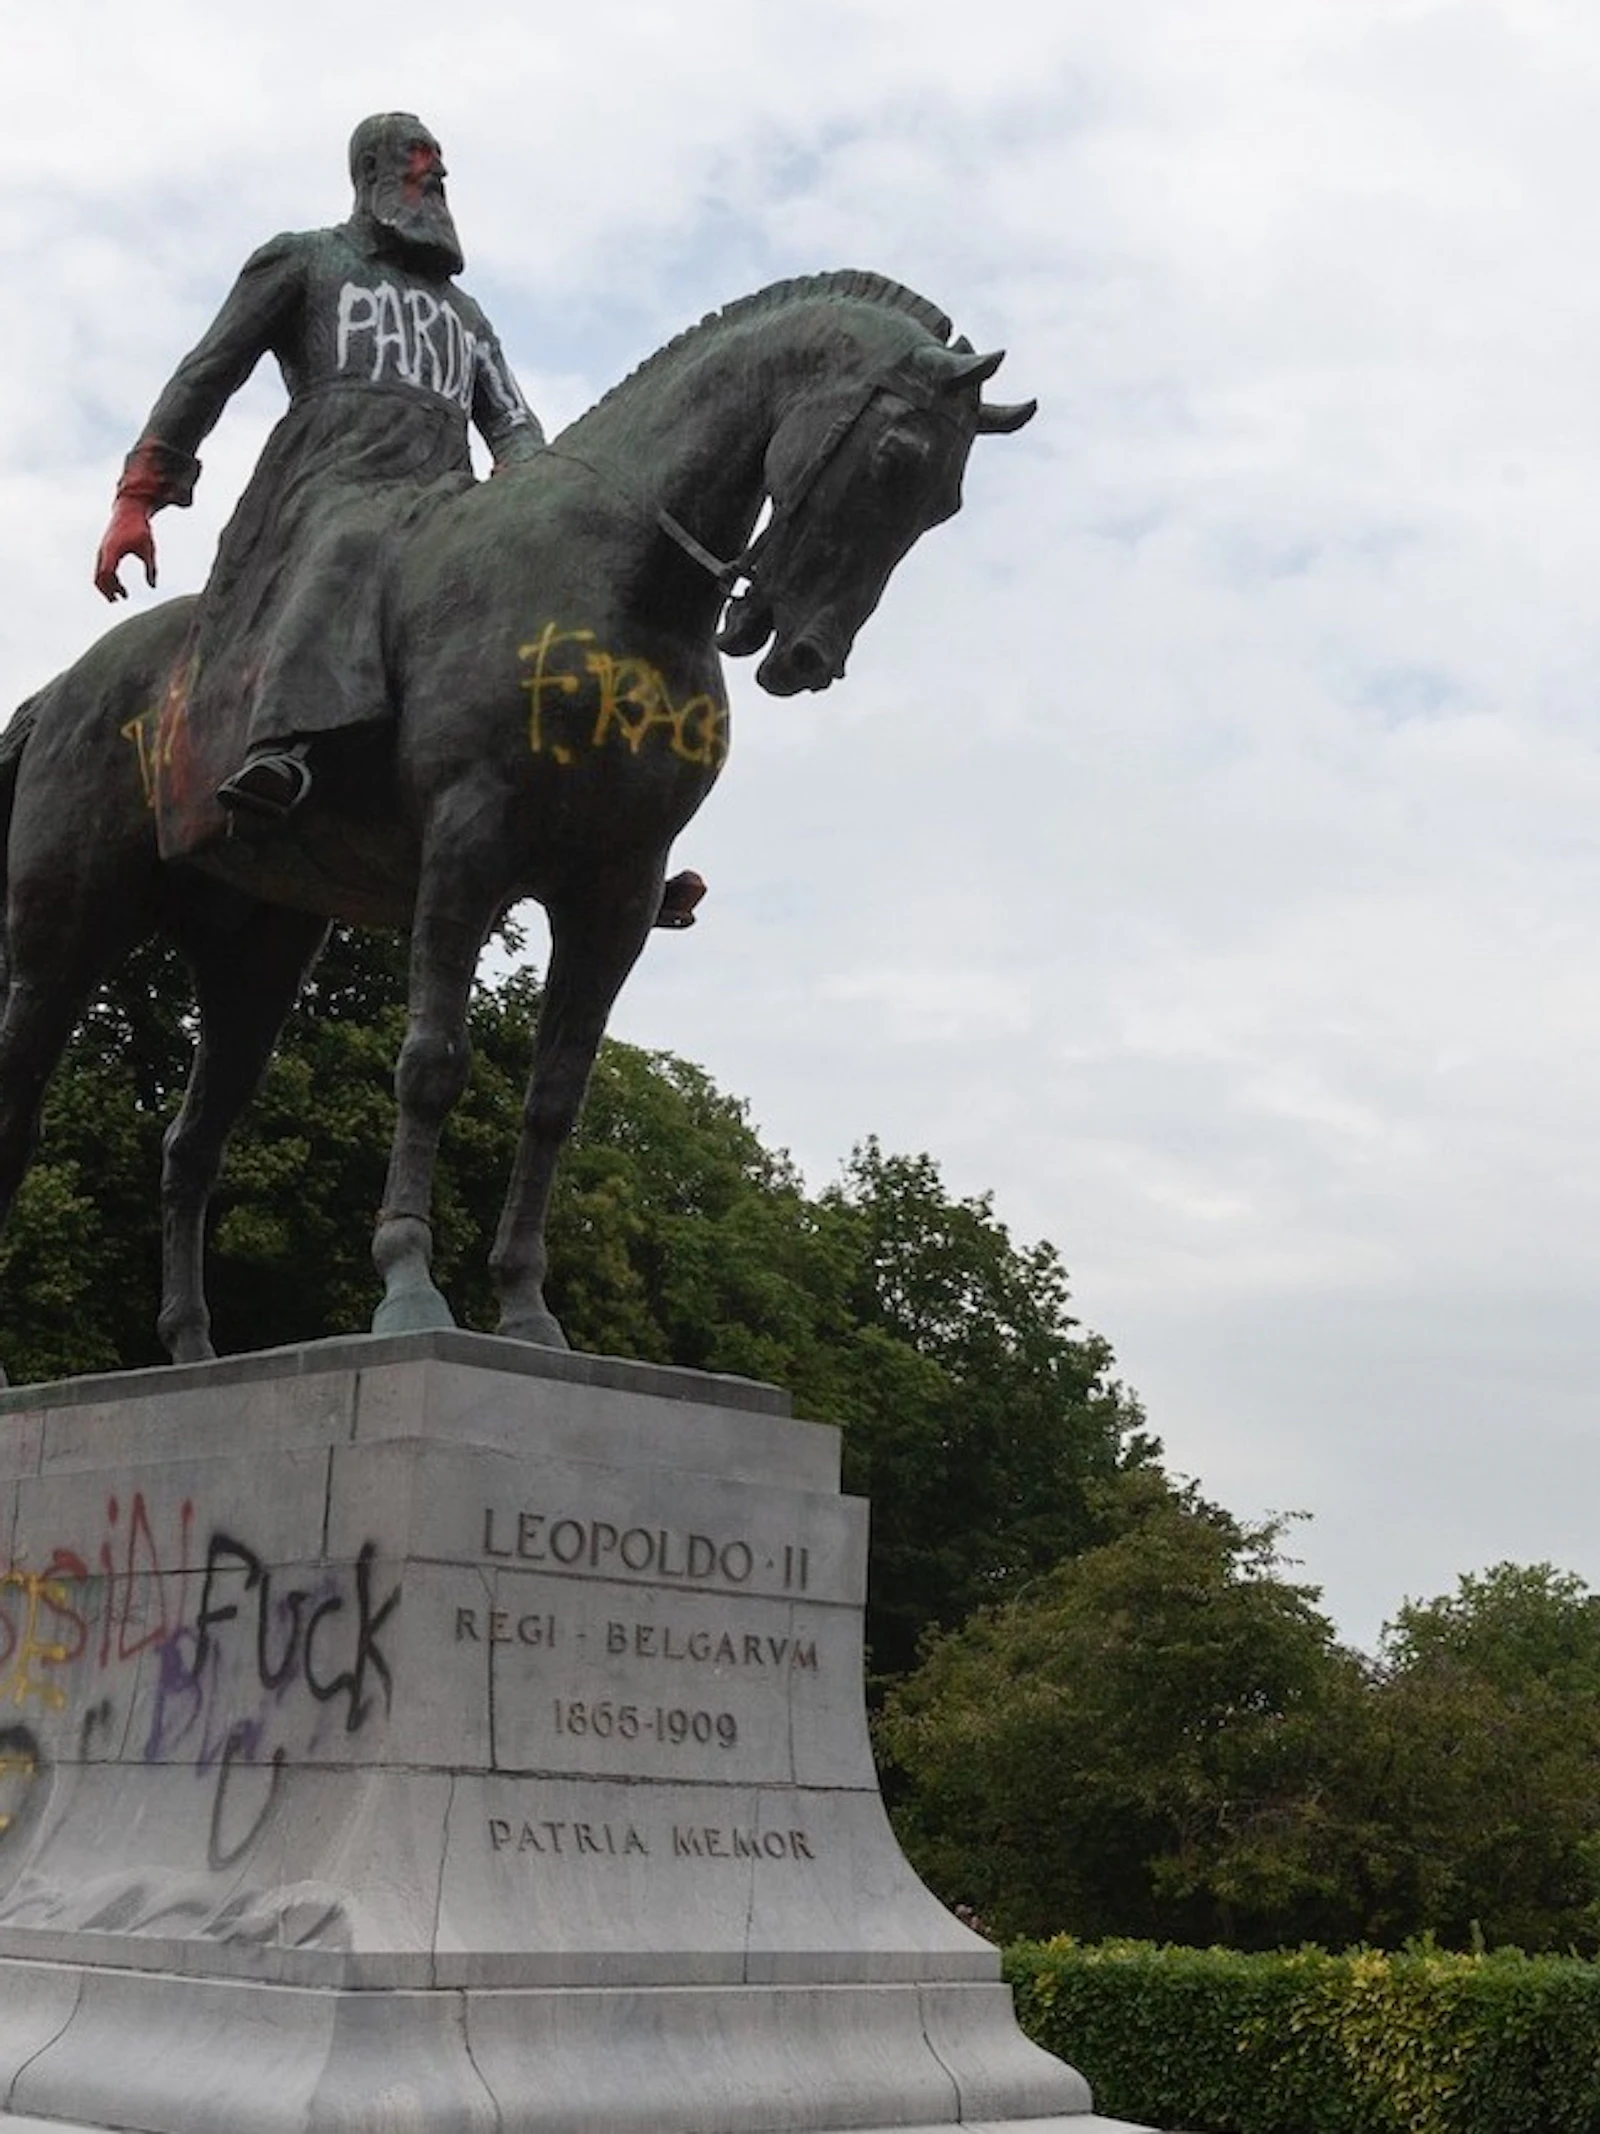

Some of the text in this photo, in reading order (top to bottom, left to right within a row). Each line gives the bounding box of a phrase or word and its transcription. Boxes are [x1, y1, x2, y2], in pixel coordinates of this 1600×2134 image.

[483, 1508, 753, 1583] LEOPOLDO
[454, 1607, 557, 1648] REGI
[605, 1620, 820, 1673] BELGARVM
[553, 1699, 739, 1749] 1865-1909
[488, 1818, 816, 1861] PATRIA MEMOR
